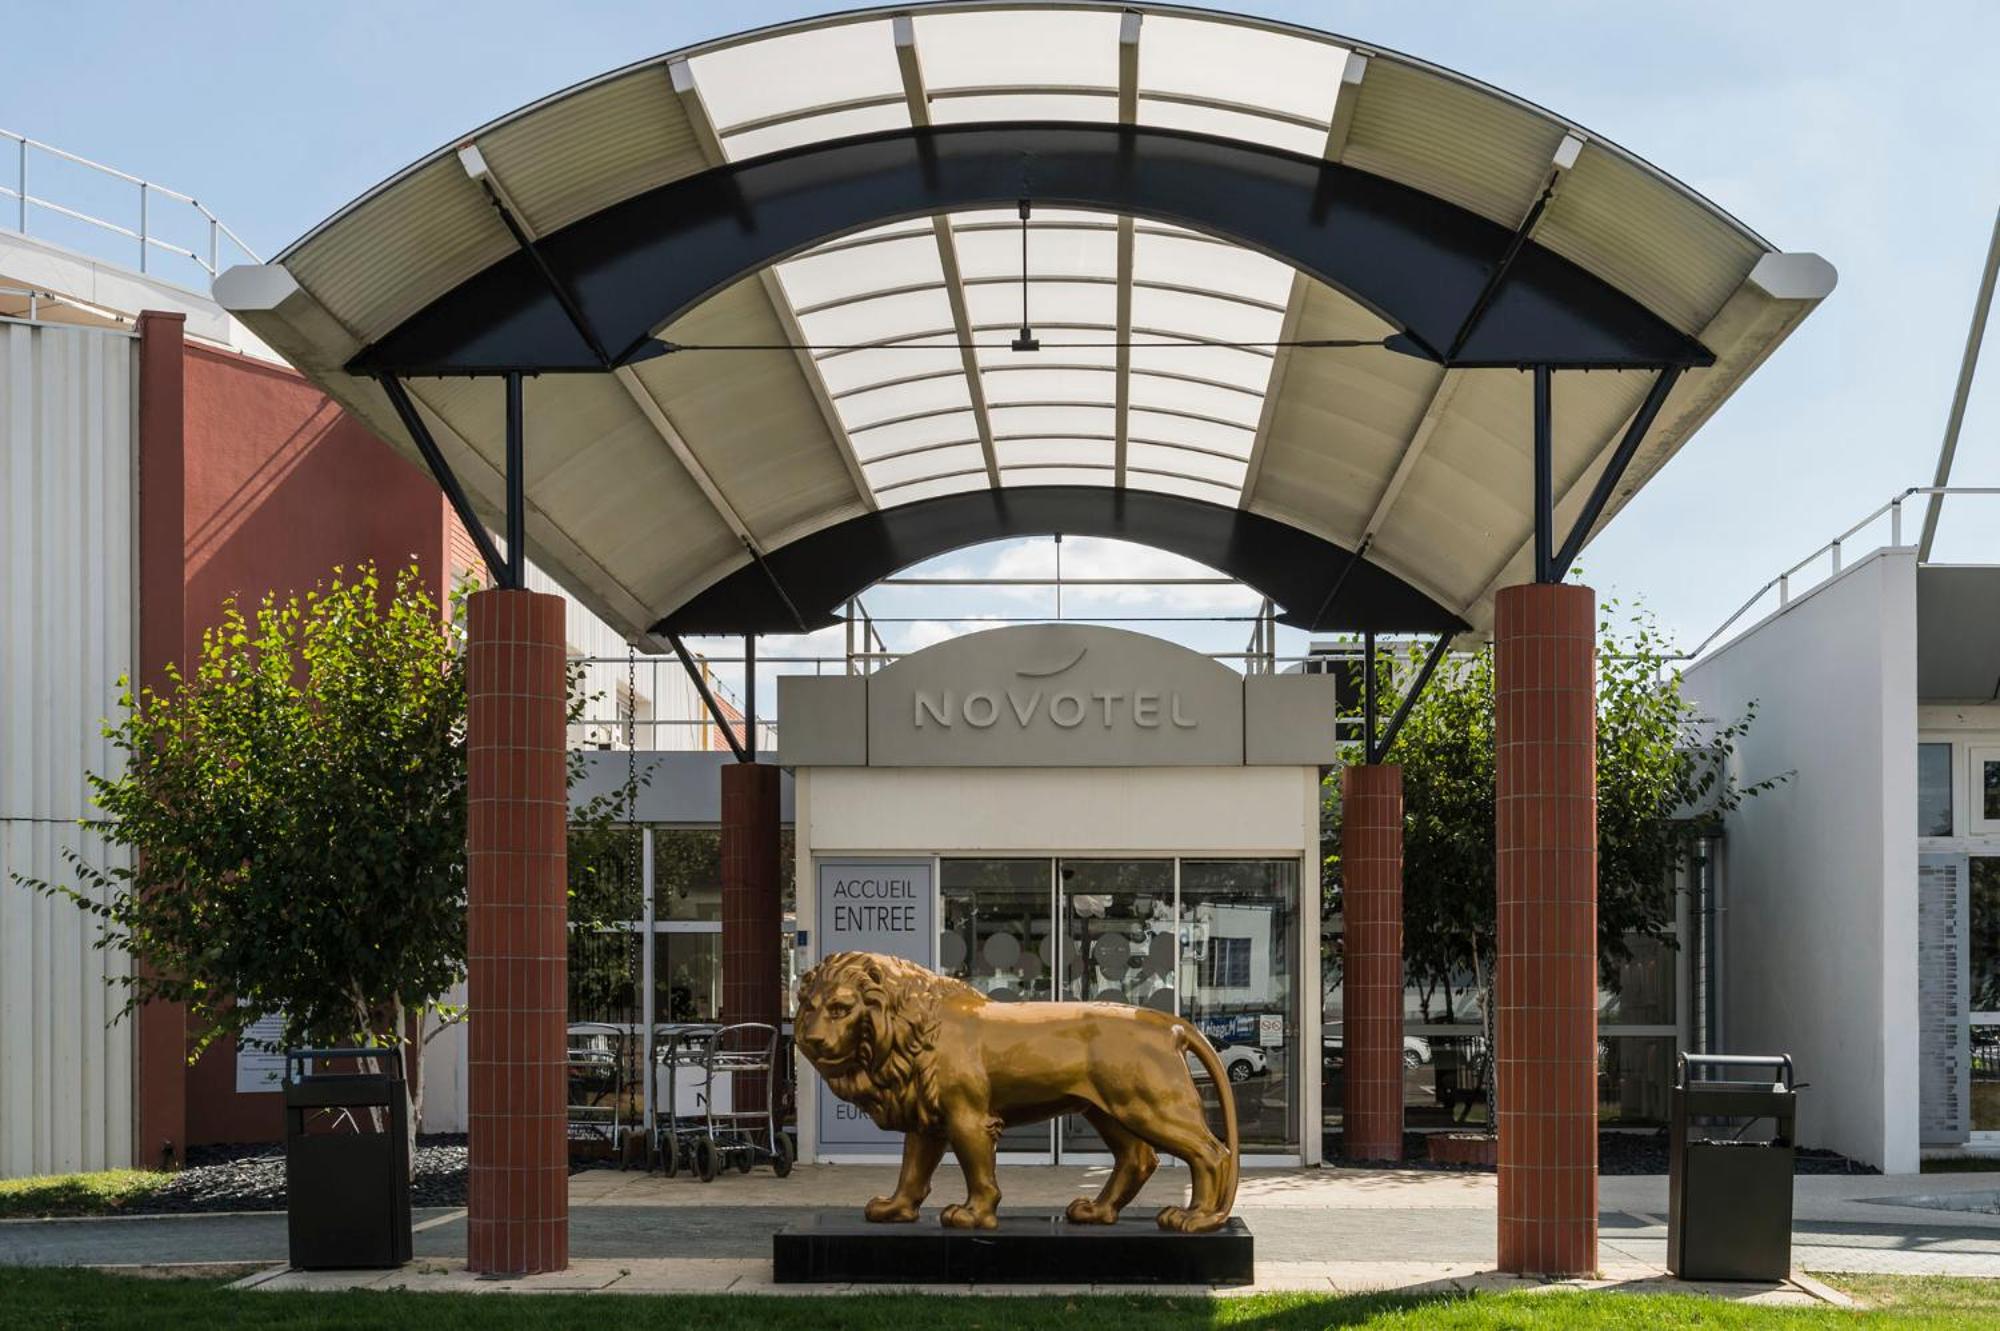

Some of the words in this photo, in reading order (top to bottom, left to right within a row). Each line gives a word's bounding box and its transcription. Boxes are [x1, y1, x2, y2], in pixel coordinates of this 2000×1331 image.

[913, 689, 1199, 730] NOVOTEL
[833, 879, 917, 899] ACCUEIL
[834, 905, 916, 932] ENTREE
